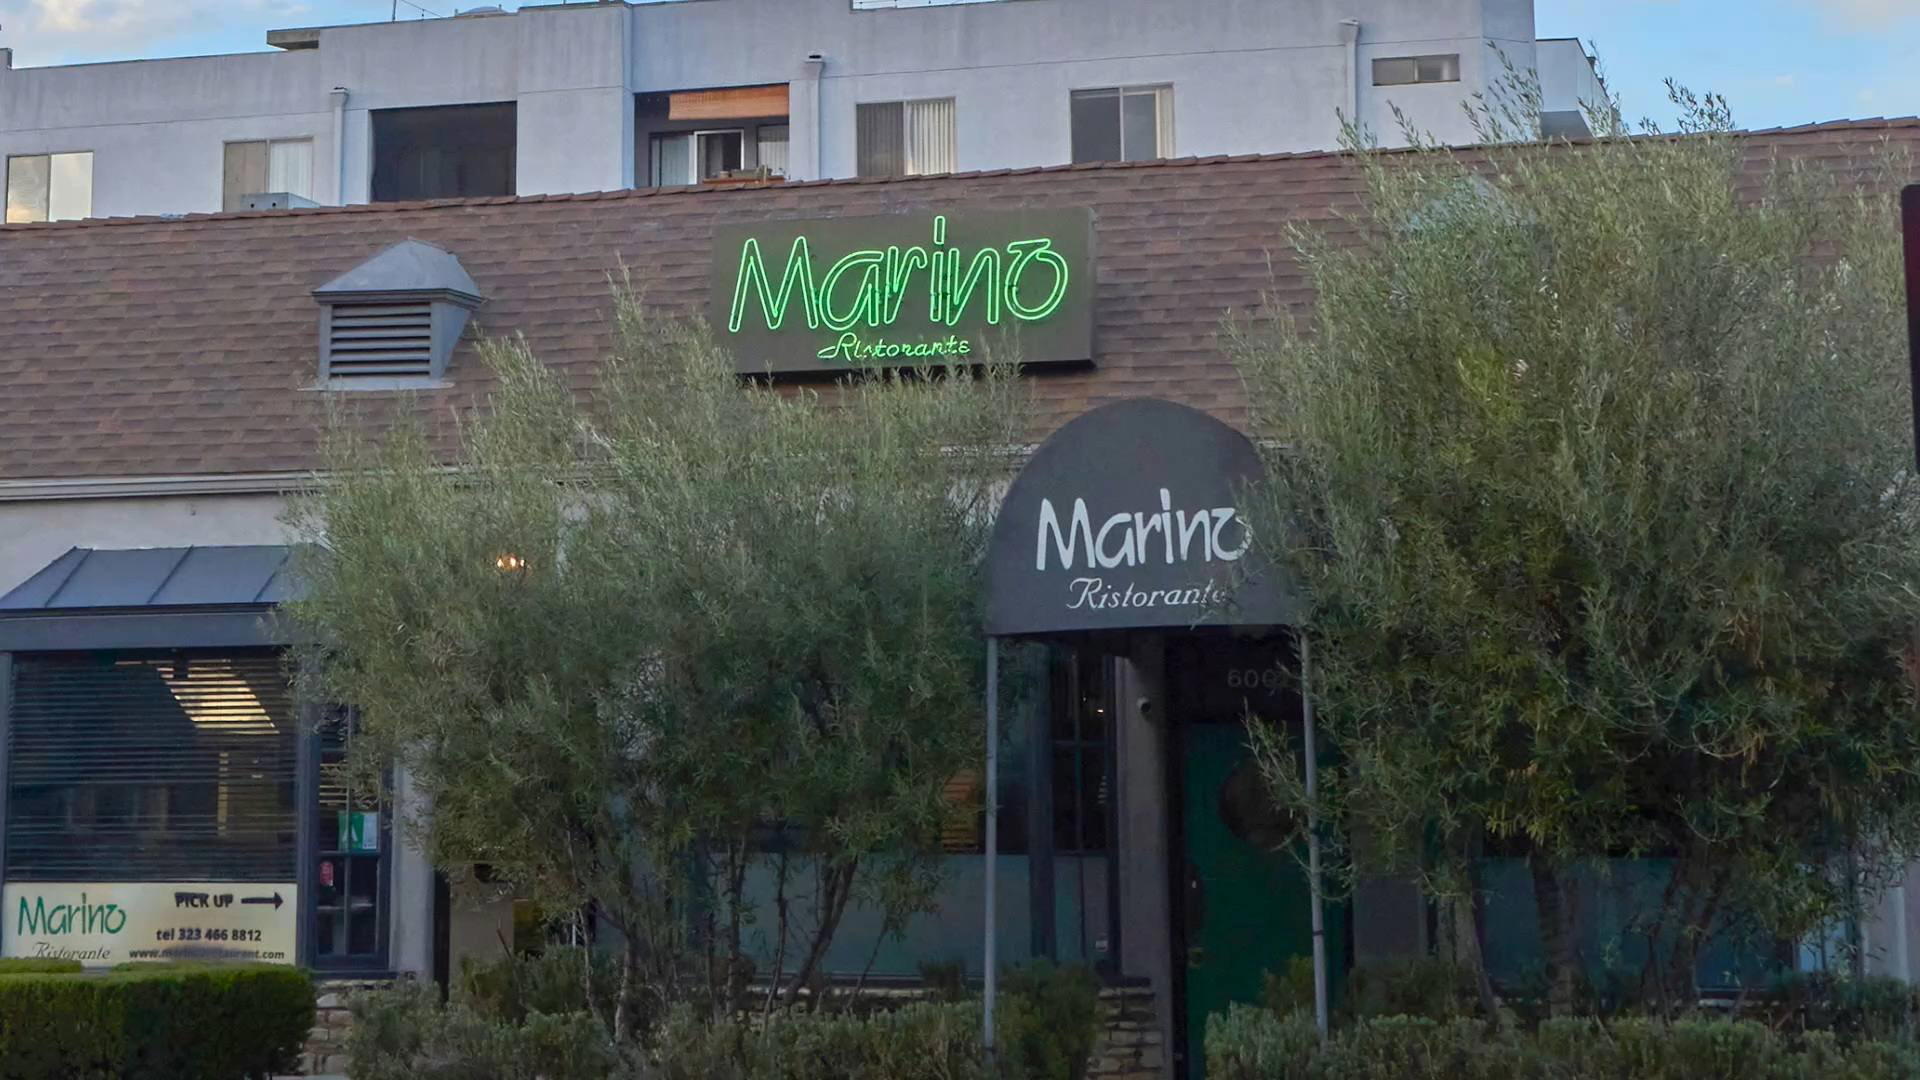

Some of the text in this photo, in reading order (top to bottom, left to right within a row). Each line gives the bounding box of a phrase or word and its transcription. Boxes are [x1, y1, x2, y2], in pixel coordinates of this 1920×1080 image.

[729, 216, 1068, 331] Marino
[817, 332, 971, 361] Ristorante
[1036, 488, 1251, 571] Marino
[18, 892, 126, 936] Marino
[174, 892, 234, 908] PICK UP
[156, 928, 262, 942] tel 323 466 8812
[32, 941, 111, 960] Ristorante
